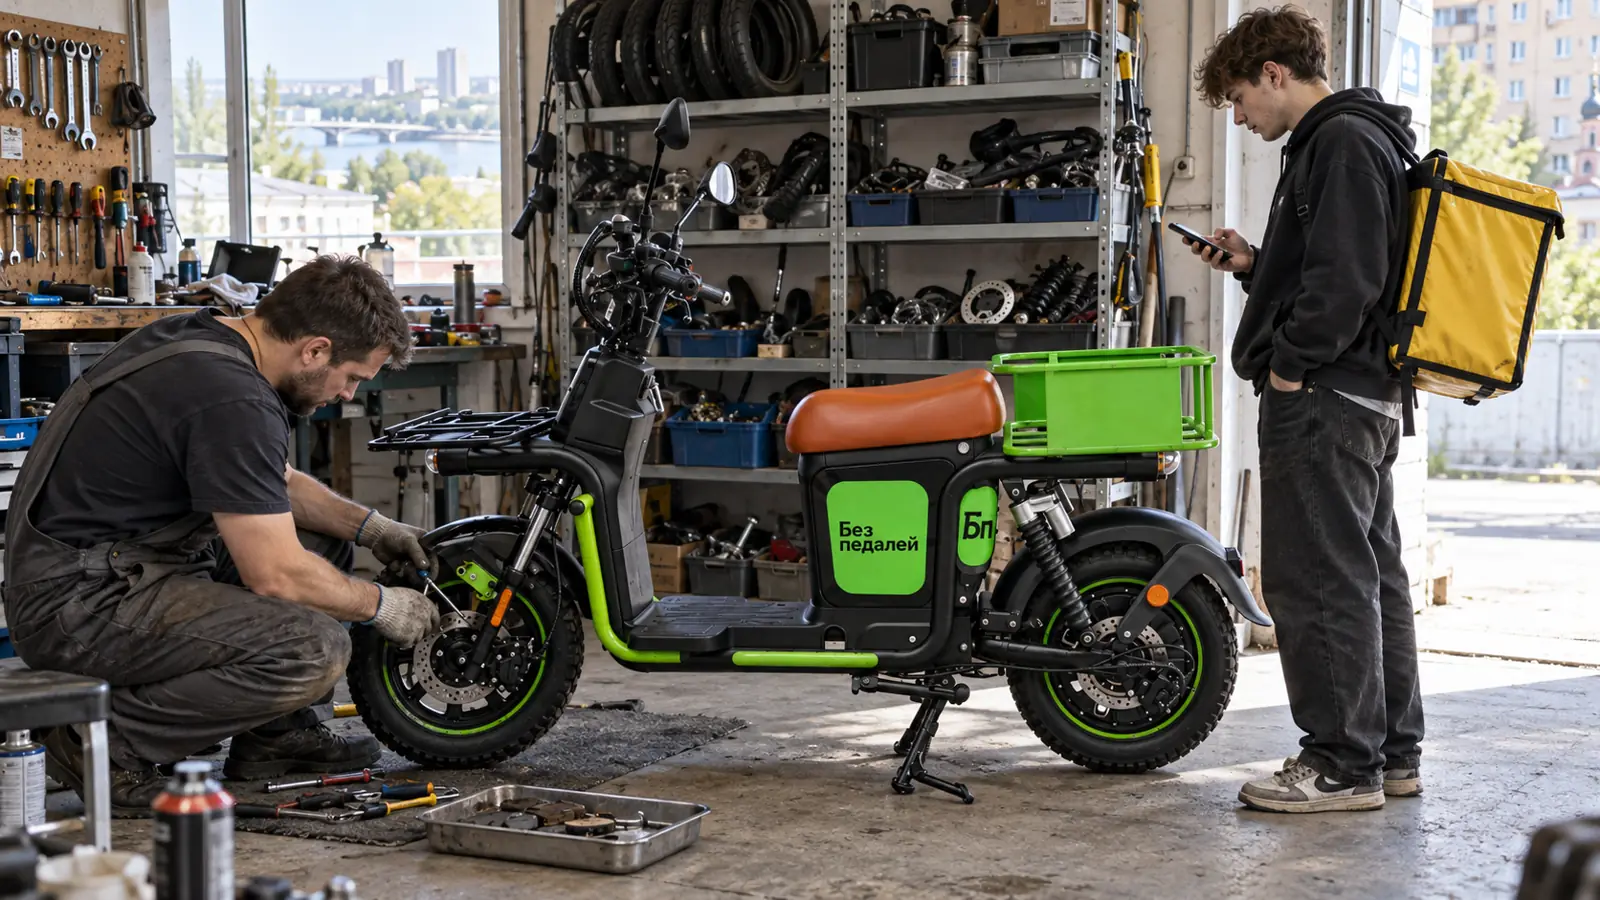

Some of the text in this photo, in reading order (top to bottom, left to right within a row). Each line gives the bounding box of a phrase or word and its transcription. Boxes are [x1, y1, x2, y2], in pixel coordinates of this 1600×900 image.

[839, 521, 873, 537] Без
[962, 511, 994, 540] Бп
[839, 536, 919, 554] педалей
